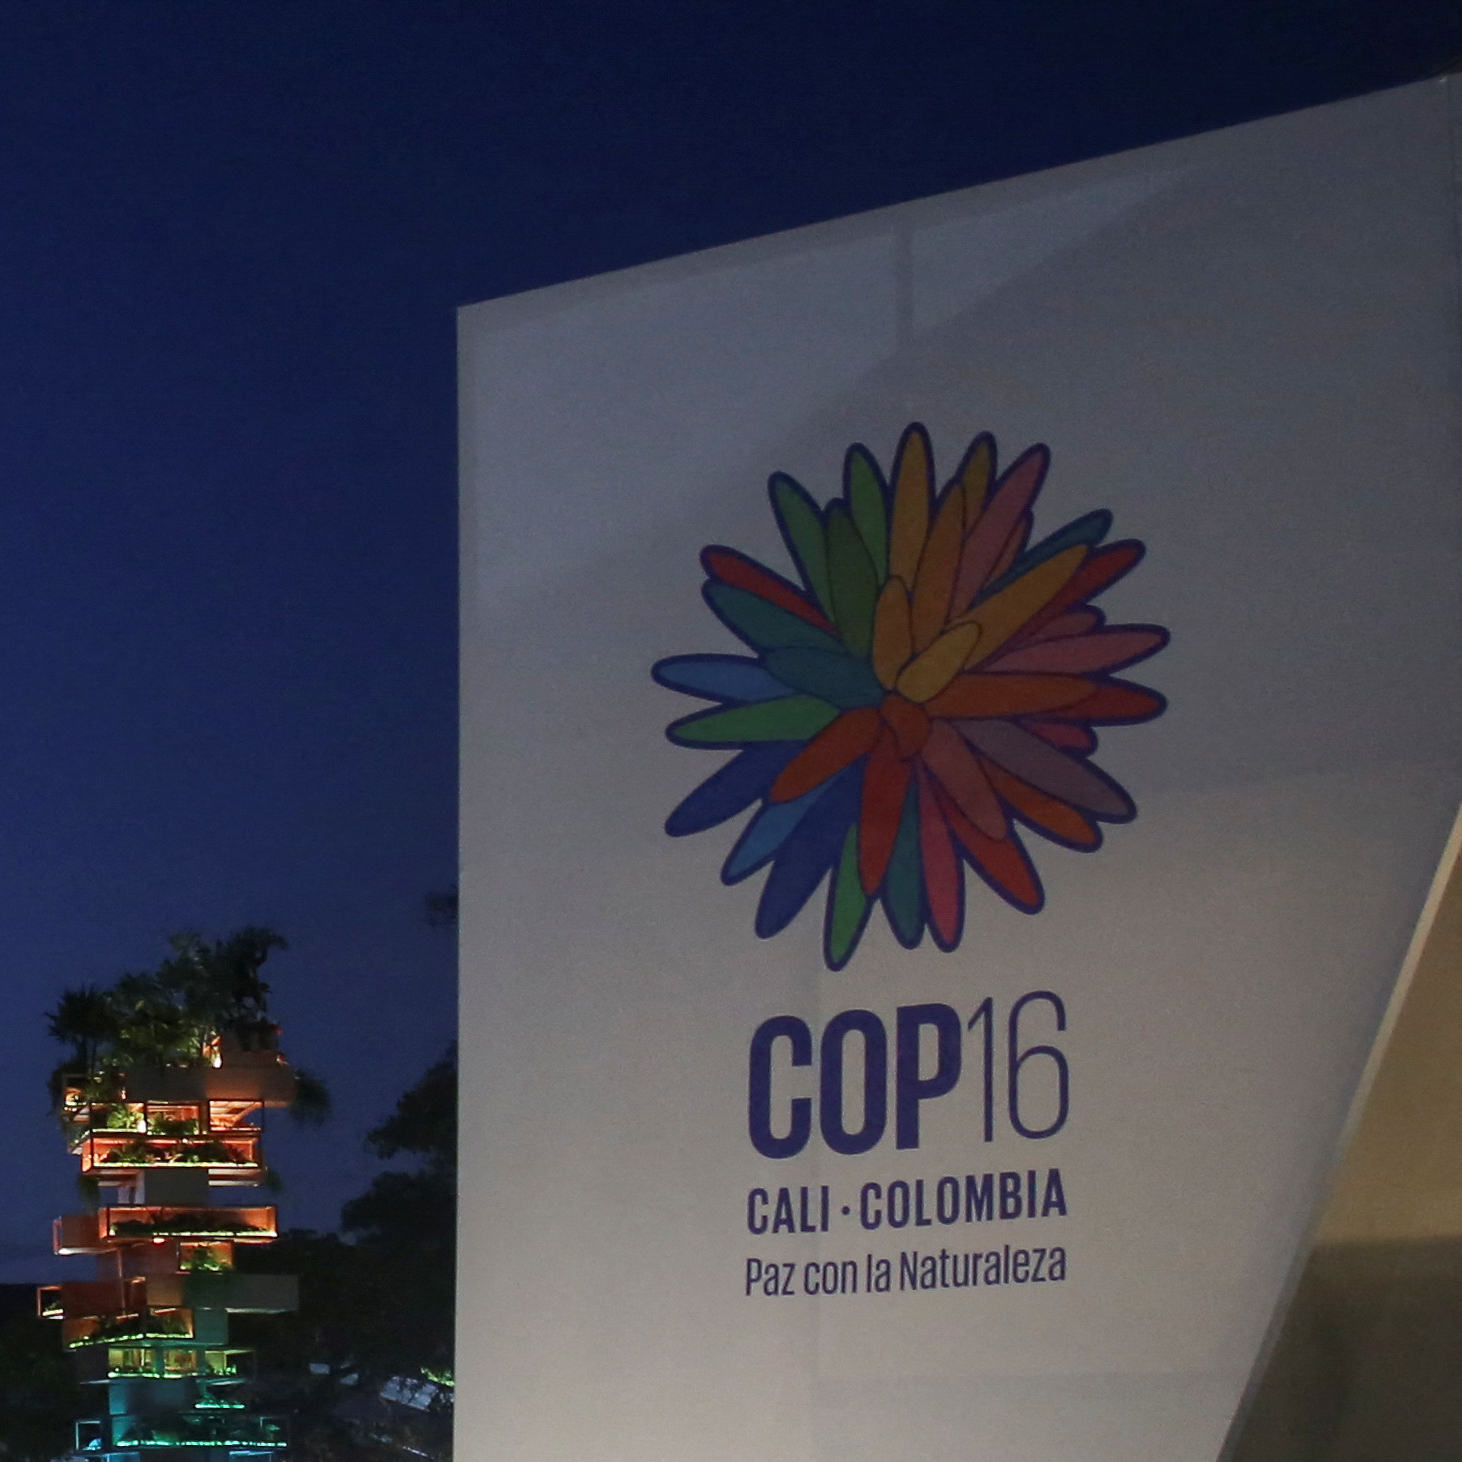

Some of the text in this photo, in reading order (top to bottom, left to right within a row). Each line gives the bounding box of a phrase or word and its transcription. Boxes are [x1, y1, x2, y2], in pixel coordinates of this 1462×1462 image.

[748, 990, 1070, 1160] COP16
[746, 1168, 1068, 1235] CALI COLOMBIA
[746, 1244, 1067, 1297] Paz con la Naturaleza
